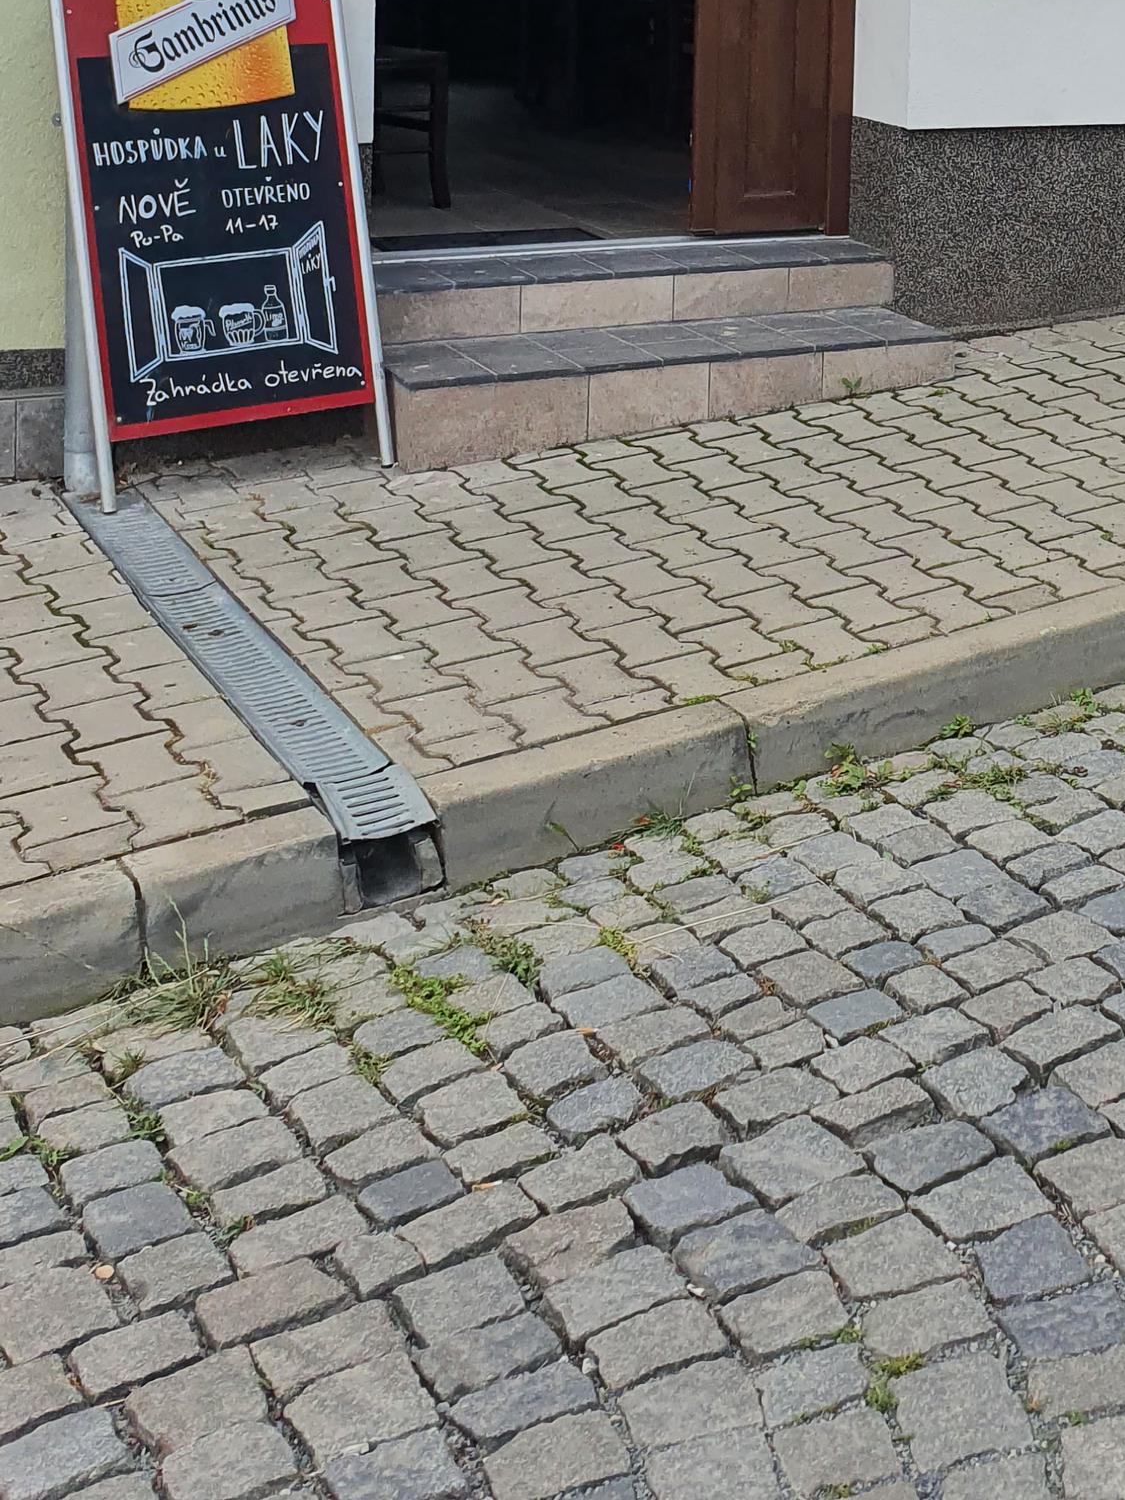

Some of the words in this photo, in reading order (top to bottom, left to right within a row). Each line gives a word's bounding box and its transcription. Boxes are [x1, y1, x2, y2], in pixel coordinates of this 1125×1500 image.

[92, 128, 207, 166] HOSPŮDKA
[232, 110, 324, 169] LAKY
[118, 178, 197, 224] NOVĚ
[221, 176, 311, 208] OTEVŘENO
[139, 373, 252, 406] Zahrádka
[264, 360, 362, 387] otevřena
